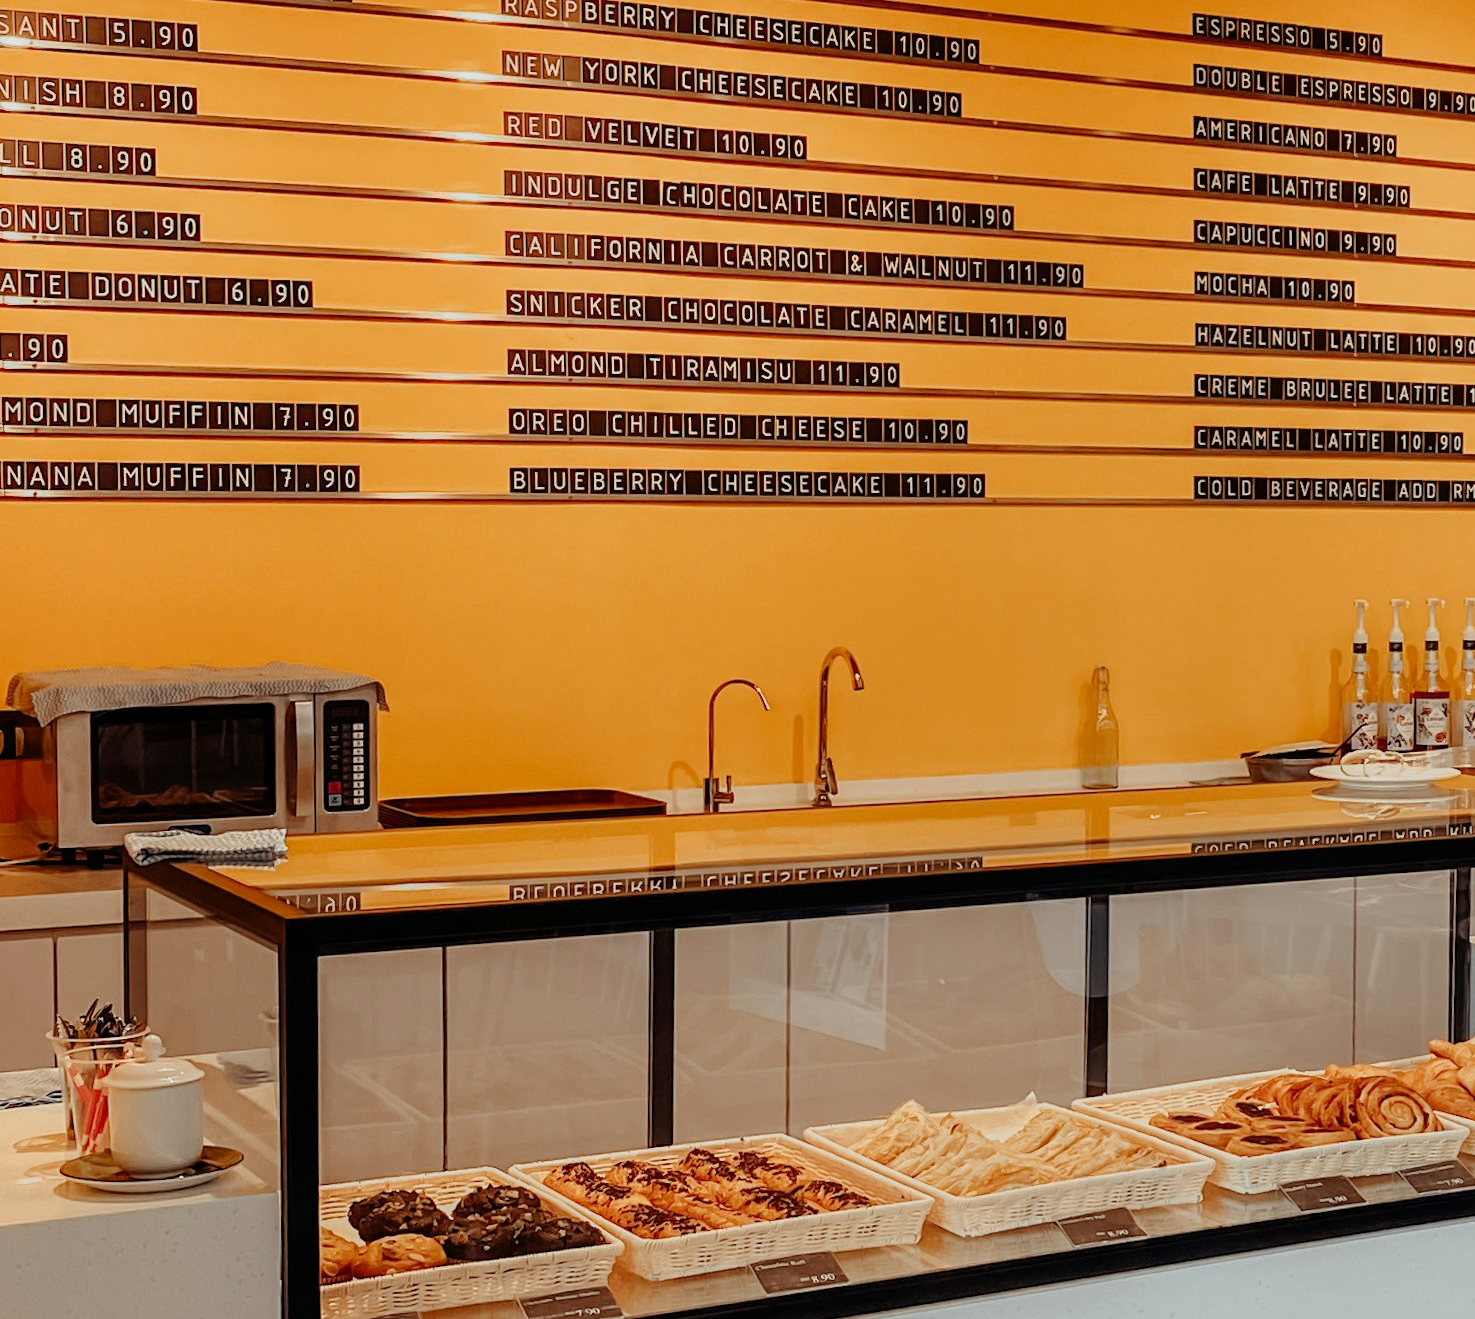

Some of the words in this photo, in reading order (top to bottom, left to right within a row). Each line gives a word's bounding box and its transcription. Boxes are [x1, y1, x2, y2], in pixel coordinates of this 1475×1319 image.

[111, 22, 195, 48] 5.90
[699, 13, 873, 52] CHEESECAKE
[899, 36, 978, 61] 10.90
[1195, 16, 1310, 47] ESPRESSO
[1329, 32, 1381, 55] 5.90
[112, 85, 194, 111] 8.90
[505, 54, 561, 78] NEW
[585, 61, 656, 86] YORK
[681, 71, 856, 105] CHEESECAKE
[882, 88, 961, 115] 10.90
[1195, 66, 1281, 94] DOUBLE
[1300, 77, 1411, 106] ESPRESSO
[506, 114, 561, 138] RED
[585, 120, 696, 149] VELVET
[721, 132, 805, 158] 10.90
[1195, 119, 1326, 149] AMERICANO
[1343, 132, 1395, 155] 7.90
[69, 148, 153, 173] 8.90
[510, 174, 638, 202] INDULGE
[666, 184, 824, 215] CHOCOLATE
[847, 196, 912, 221] CAKE
[935, 204, 1012, 230] 10.90
[1196, 170, 1251, 193] CAFE
[1270, 176, 1339, 200] LATTE
[1357, 184, 1409, 206] 9.90
[114, 213, 197, 238] 6.90
[1196, 222, 1326, 250] CAPUCCINO
[1343, 232, 1395, 254] 9.90
[509, 233, 700, 265] CALIFORNIA
[719, 244, 827, 271] CARROT
[850, 252, 865, 273] &
[883, 254, 985, 280] WALNUT
[1008, 263, 1083, 286] 11.90
[94, 275, 201, 301] DONUT
[230, 282, 310, 306] 6.90
[1196, 274, 1269, 297] MOCHA
[1288, 280, 1354, 301] 10.90
[509, 292, 642, 319] SNICKER
[666, 299, 826, 327] CHOCOLATE
[849, 309, 966, 334] CARAMEL
[989, 315, 1065, 339] 11.90
[1197, 326, 1312, 349] HAZELNUT
[1329, 330, 1396, 352] LATTE
[509, 352, 624, 376] ALMOND
[649, 357, 792, 382] TIRAMISU
[818, 363, 898, 386] 11.90
[1197, 377, 1268, 398] CREME
[1285, 379, 1369, 401] BRULEE
[1386, 384, 1450, 404] LATTE
[3, 401, 92, 425] MOND
[121, 404, 249, 427] MUFFIN
[279, 405, 355, 428] 7.90
[511, 411, 586, 434] OREO
[611, 414, 737, 437] CHILLED
[761, 418, 864, 439] CHEESE
[887, 420, 966, 441] 10.90
[1197, 428, 1296, 449] CARAMEL
[1313, 431, 1381, 450] LATTE
[1400, 433, 1462, 452] 10.90
[7, 464, 93, 488] NANA
[123, 465, 250, 488] MUFFIN
[280, 467, 356, 489] 7.90
[512, 470, 683, 493] BLUEBERRY
[706, 473, 882, 495] CHEESECAKE
[905, 475, 984, 496] 11.90
[1196, 479, 1252, 498] COLD
[1270, 480, 1381, 500] BEVERAGE
[1399, 482, 1437, 500] ADD
